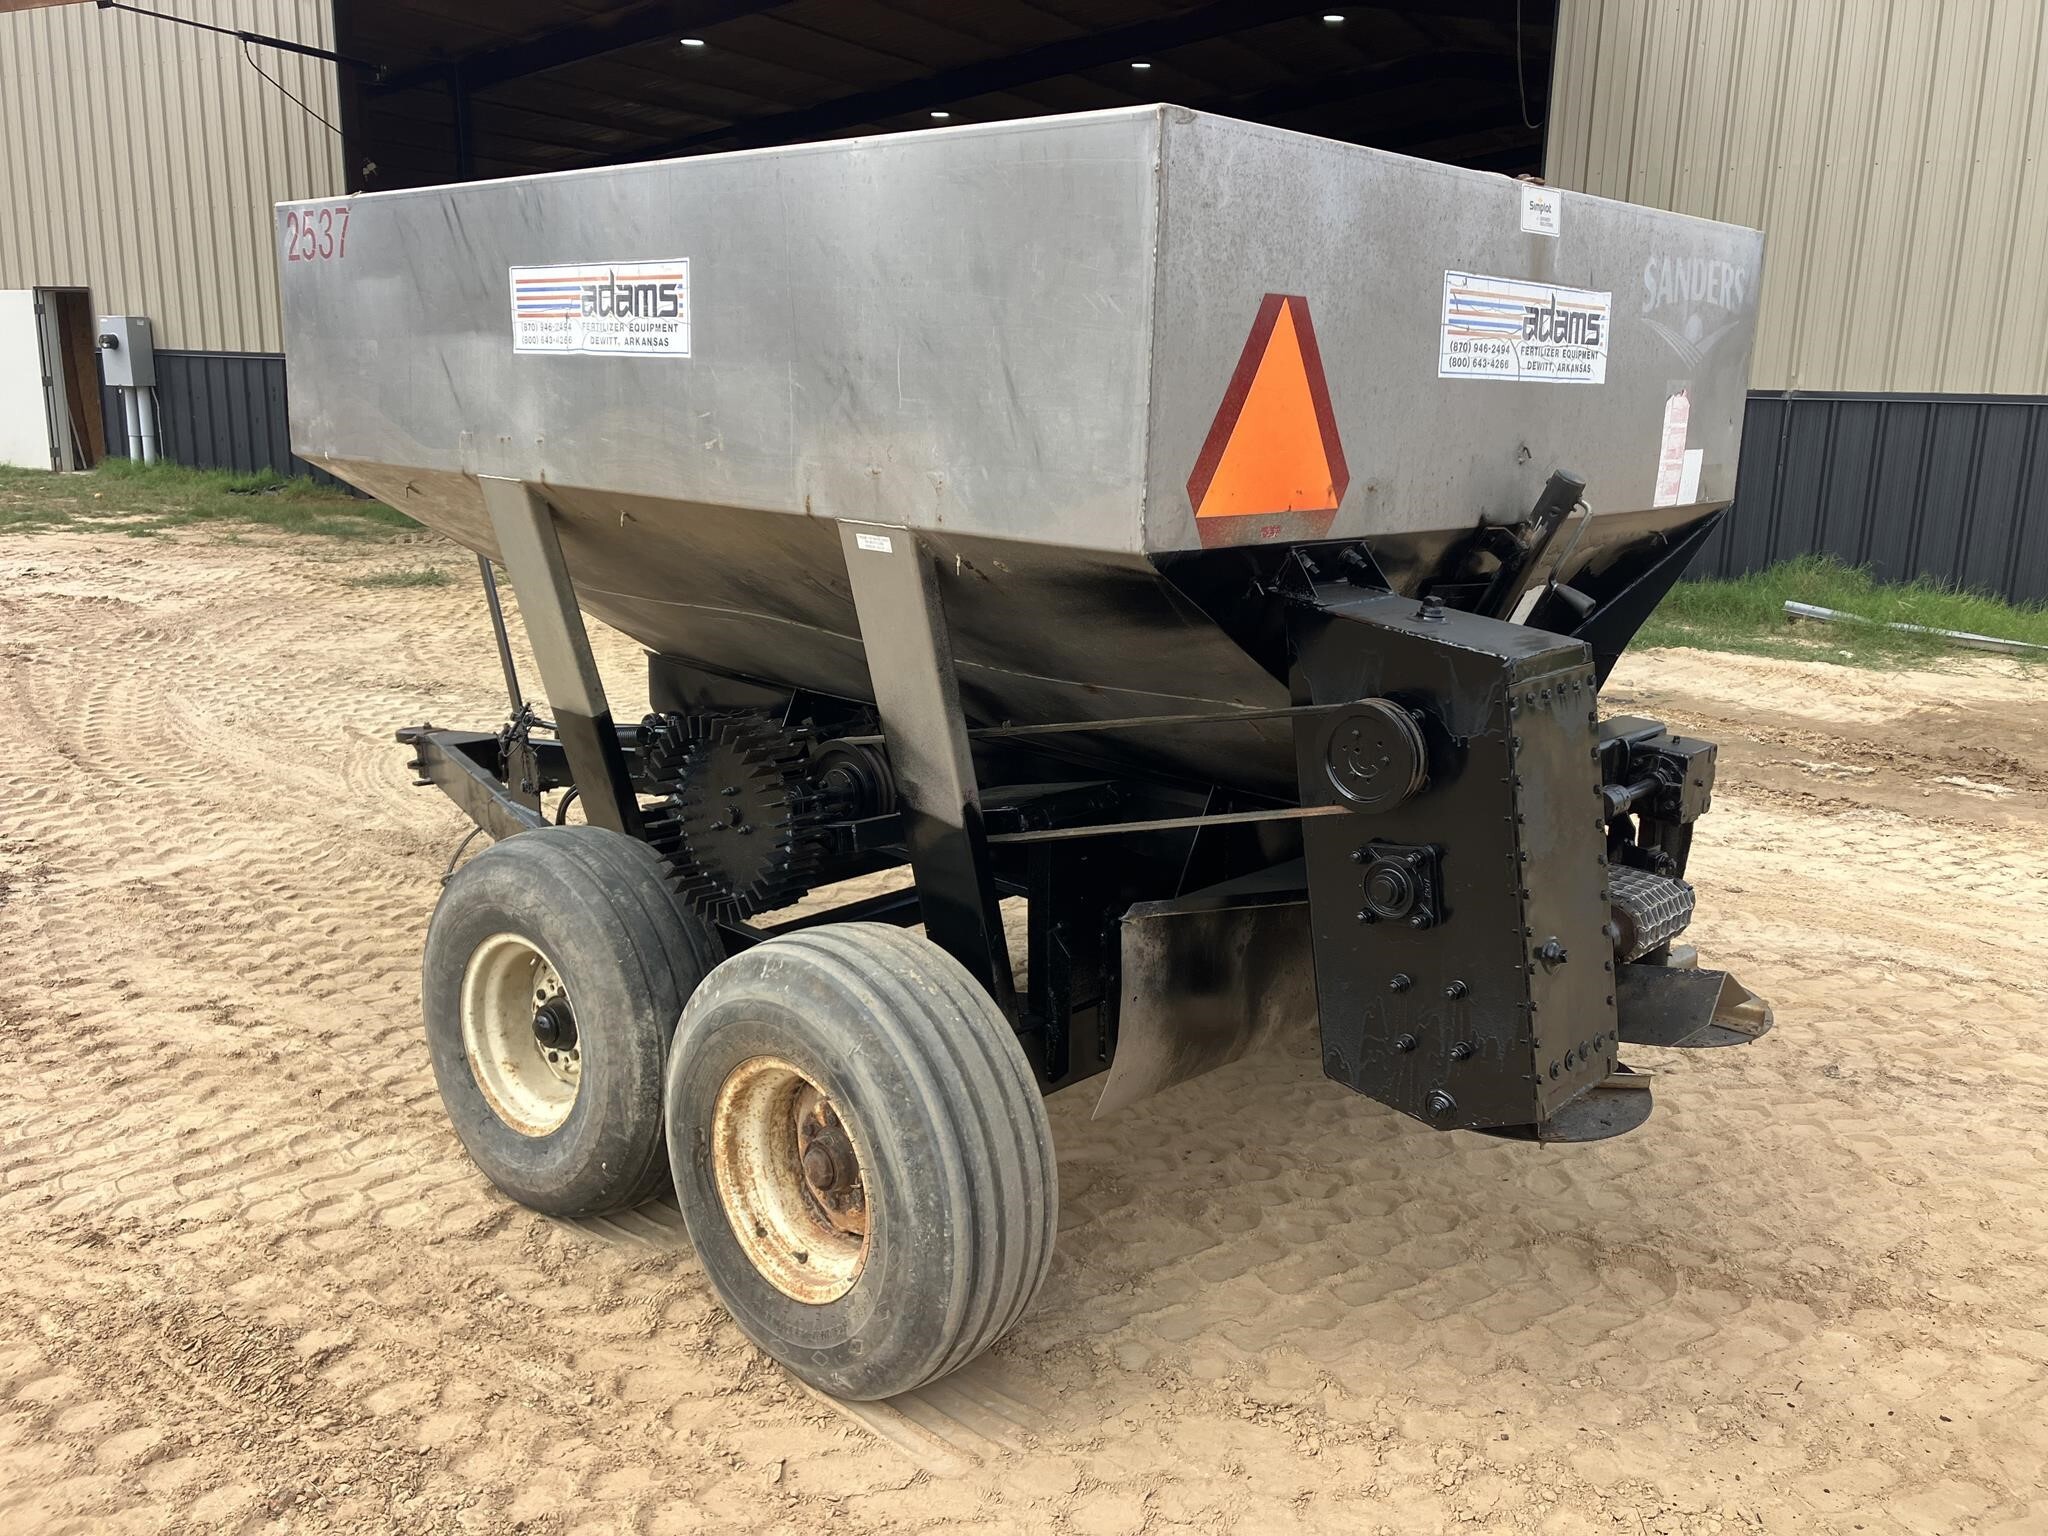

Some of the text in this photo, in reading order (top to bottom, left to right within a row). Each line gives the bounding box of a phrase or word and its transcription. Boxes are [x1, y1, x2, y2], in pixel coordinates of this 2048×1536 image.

[287, 207, 350, 261] 2537
[1641, 256, 1746, 313] SANDERS
[581, 267, 678, 318] adams
[1522, 292, 1601, 346] adams
[582, 322, 679, 333] FERTILIZER EQUIPMENT
[624, 337, 669, 347] ARKANSAS
[1449, 340, 1472, 354] (870)
[1521, 345, 1599, 360] FERTILIZER EQUIPMENT
[1448, 357, 1470, 369] (800)
[1526, 361, 1591, 374] DEWITT, ARKANSAS
